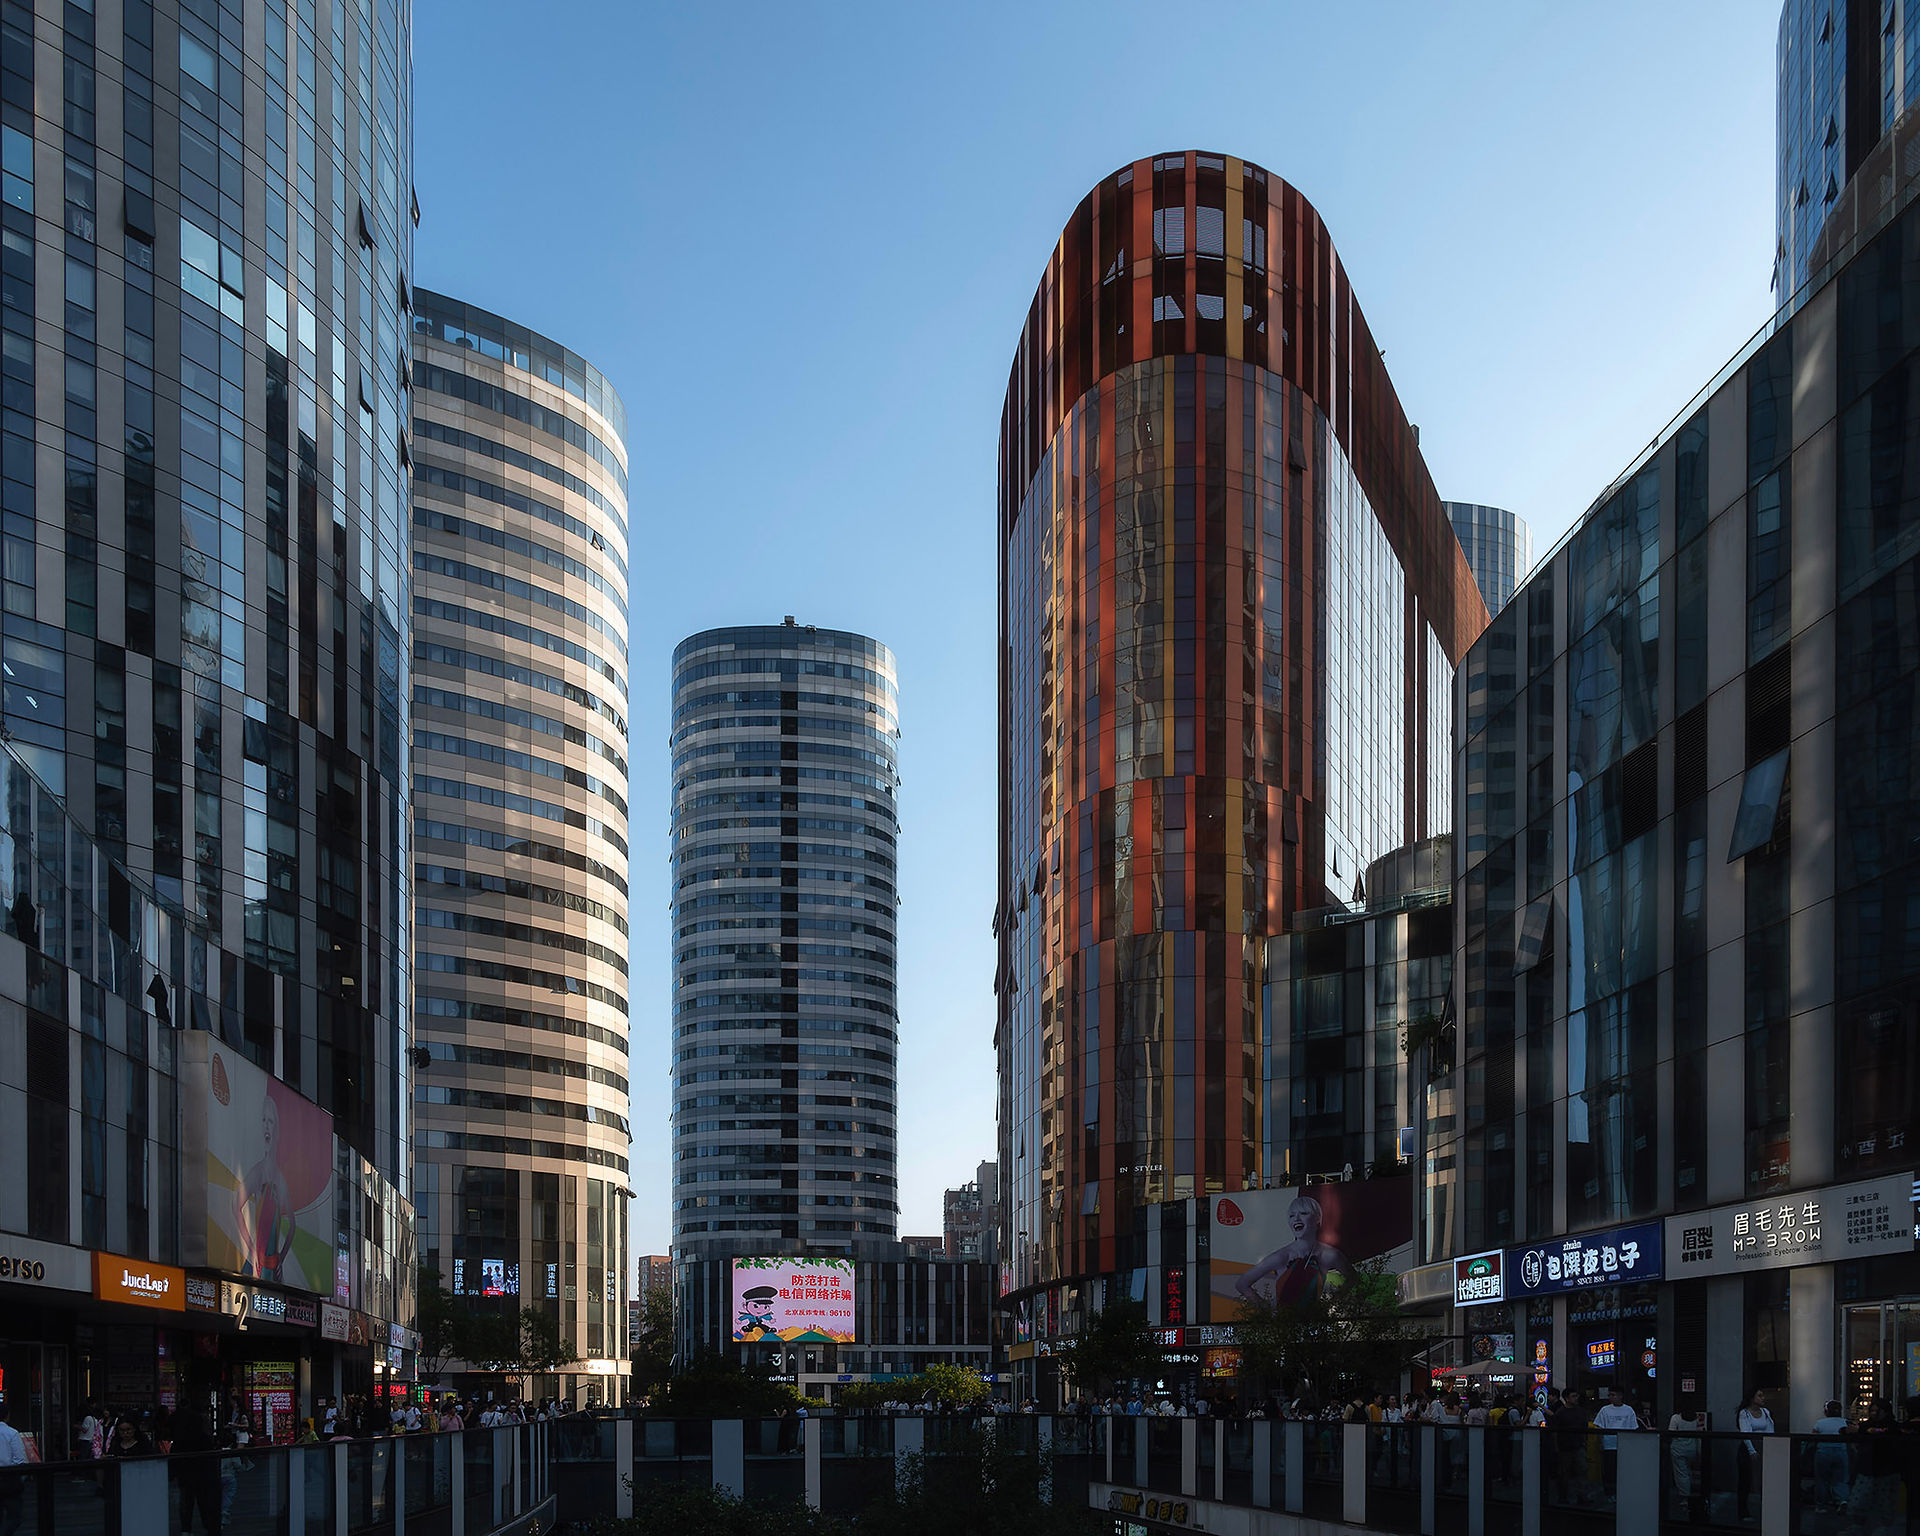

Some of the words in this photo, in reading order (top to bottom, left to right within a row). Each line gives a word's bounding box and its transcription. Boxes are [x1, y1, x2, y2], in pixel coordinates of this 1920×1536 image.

[1733, 1201, 1821, 1236] 眉毛先生
[1682, 1226, 1713, 1250] 眉型
[1766, 1227, 1821, 1248] BROW
[1546, 1241, 1640, 1281] 包馔夜包子
[1736, 1250, 1772, 1262] Professional
[1774, 1246, 1801, 1258] Eyebrow
[1803, 1243, 1822, 1253] Salon
[791, 1274, 841, 1287] 防范打击
[1458, 1274, 1501, 1301] 长沙臭豆腐
[779, 1287, 852, 1301] 电信网络诈骗
[234, 1291, 249, 1331] 2
[829, 1309, 851, 1317] 96110
